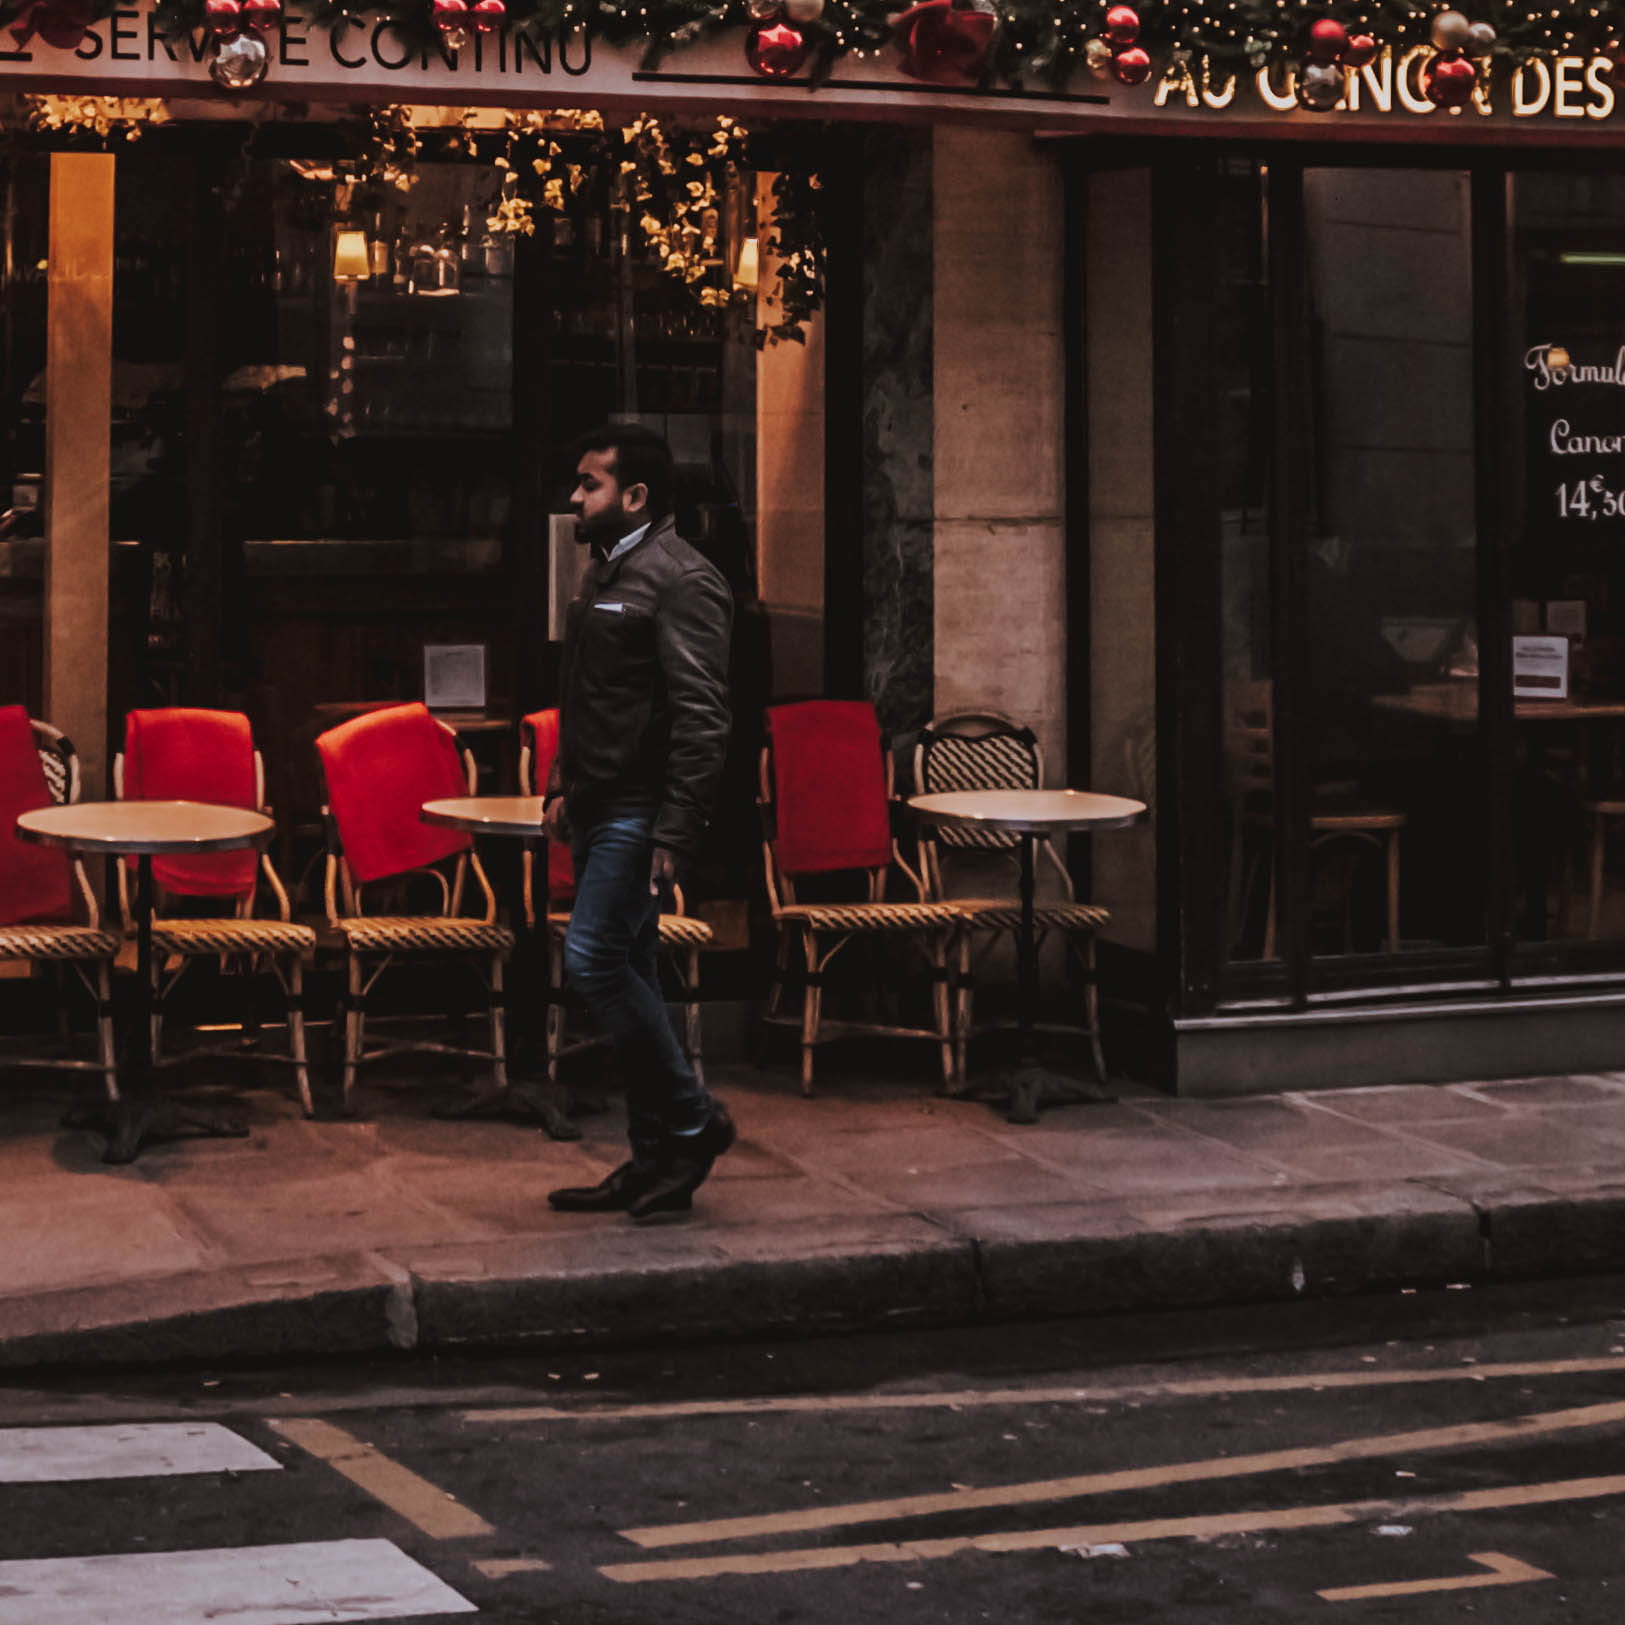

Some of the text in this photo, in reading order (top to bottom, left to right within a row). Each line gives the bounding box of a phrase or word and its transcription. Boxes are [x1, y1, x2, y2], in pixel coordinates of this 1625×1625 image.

[74, 10, 310, 68] SERVE
[1153, 53, 1237, 109] AU
[1255, 44, 1493, 117] CNO
[1512, 56, 1616, 121] DES
